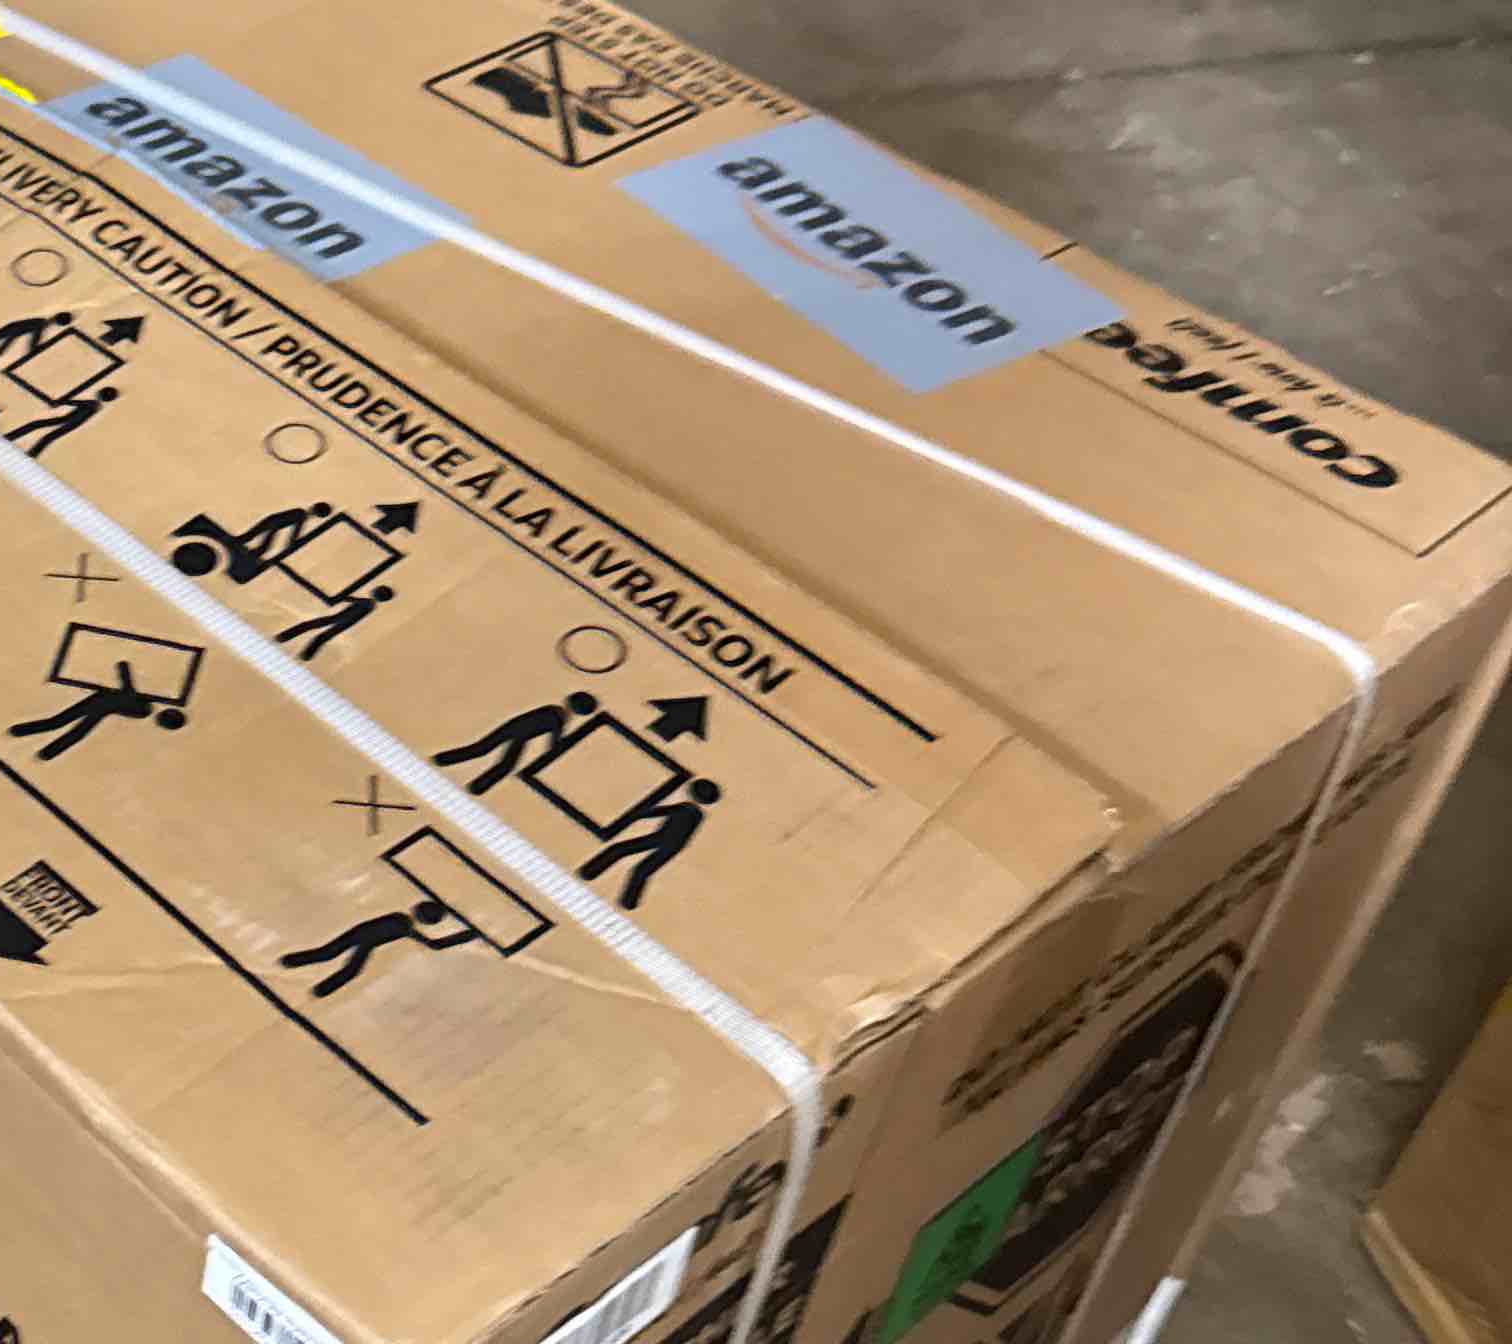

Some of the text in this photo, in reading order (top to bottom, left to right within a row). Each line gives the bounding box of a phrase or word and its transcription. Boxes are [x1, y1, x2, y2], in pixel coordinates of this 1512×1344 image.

[87, 95, 366, 261] amazon
[715, 154, 1020, 347] amazon
[93, 220, 252, 330] CAUTION
[261, 334, 476, 478] PRUDENCE
[493, 488, 560, 538] LA
[551, 524, 798, 694] LIVRAISON
